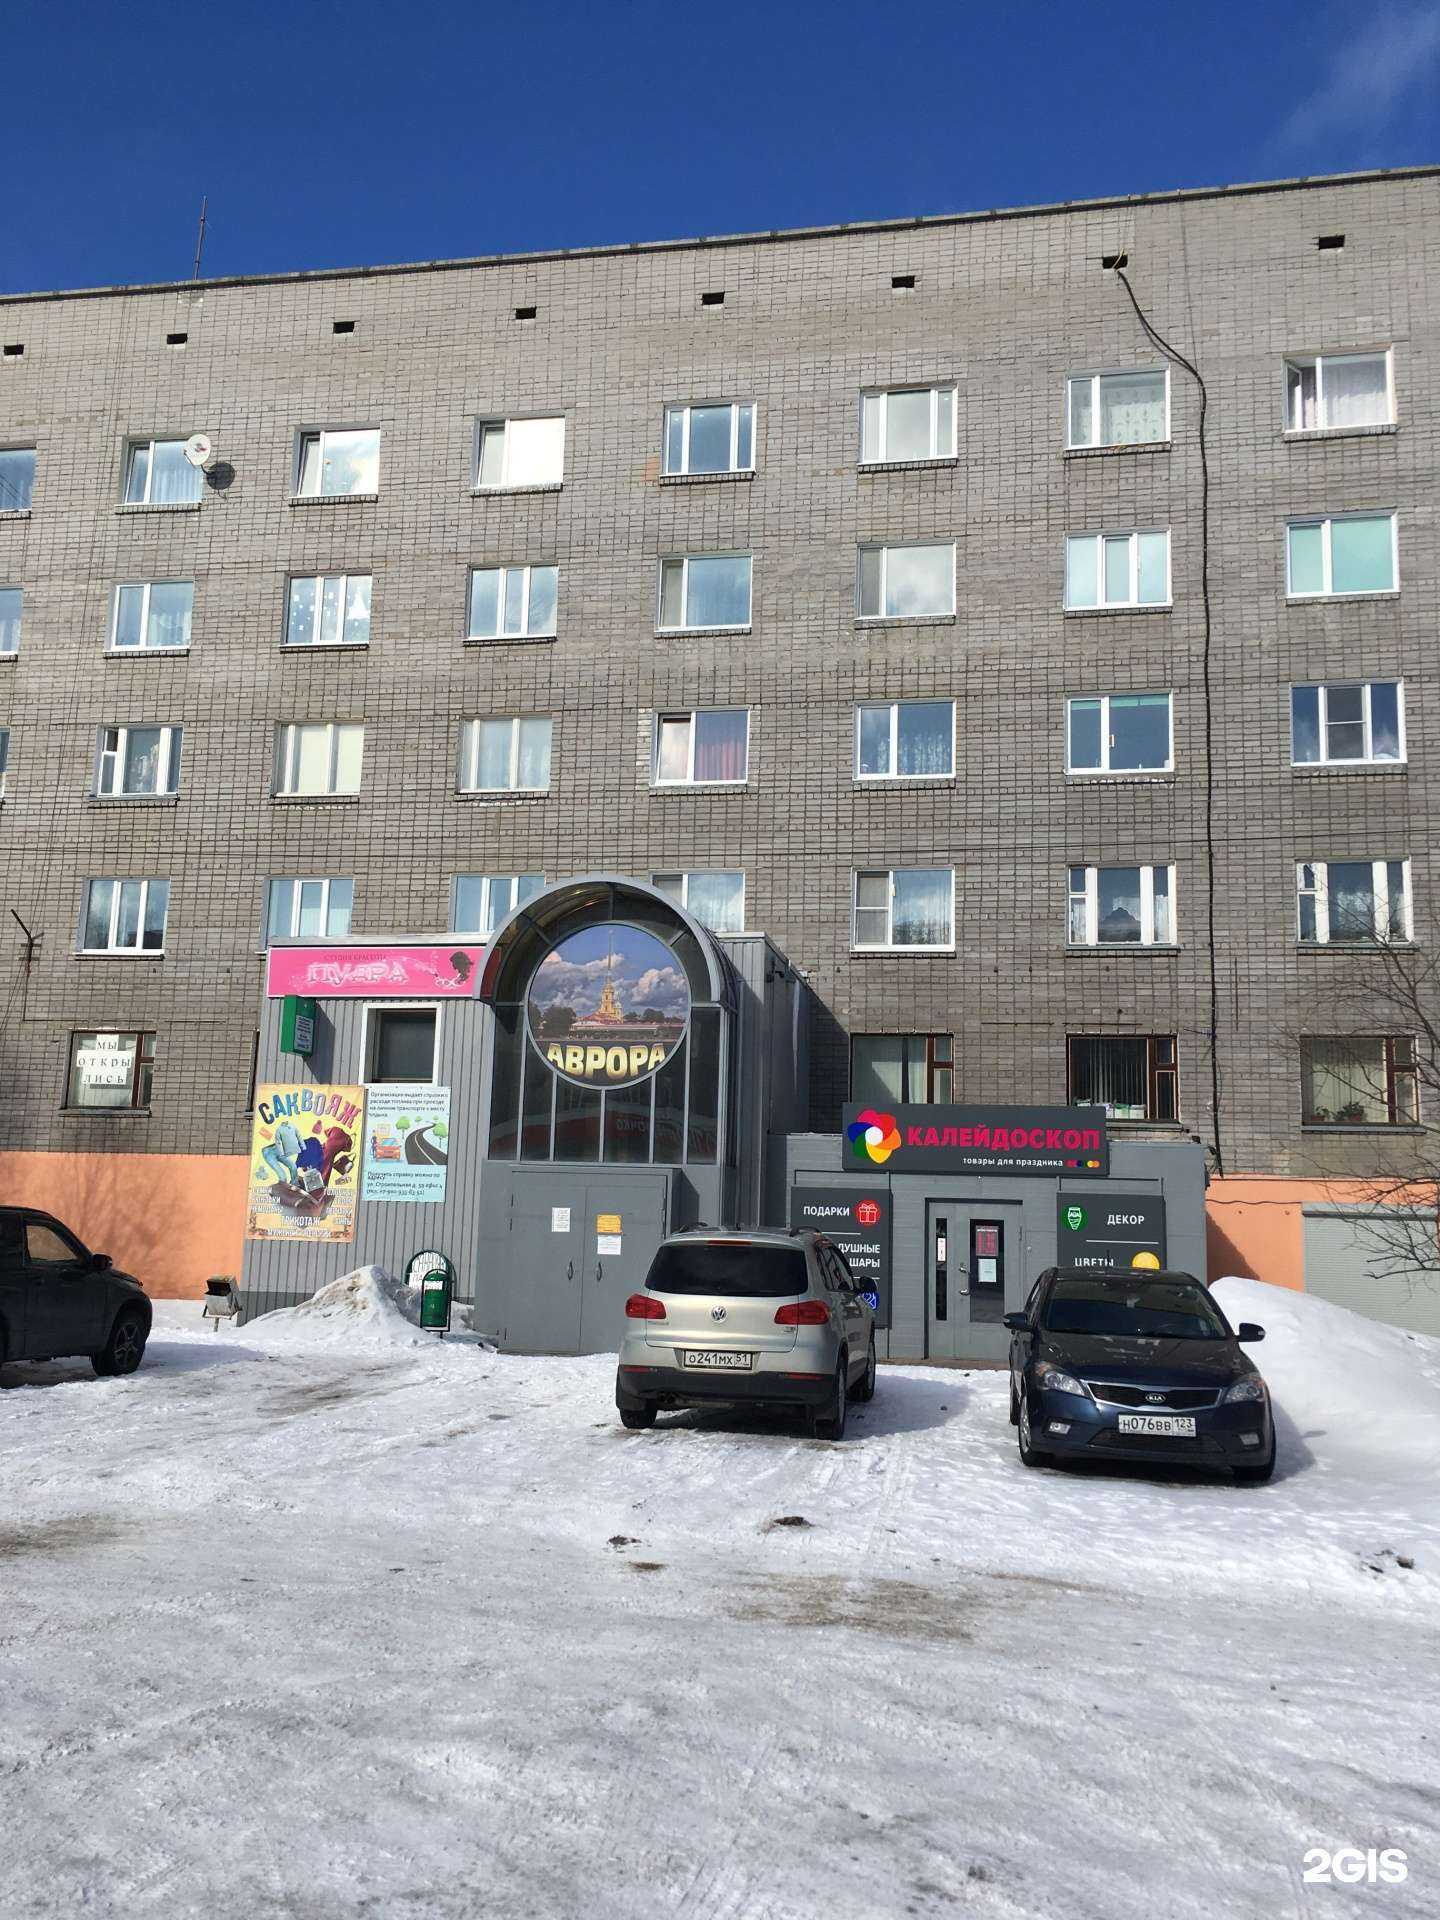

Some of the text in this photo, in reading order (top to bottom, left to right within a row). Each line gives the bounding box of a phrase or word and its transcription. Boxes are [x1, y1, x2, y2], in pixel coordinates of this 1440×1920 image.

[307, 962, 409, 987] ПУДРА
[97, 1041, 118, 1050] МЫ
[547, 1042, 666, 1079] АВРОРА
[258, 1087, 362, 1129] САКВОЯЖ
[907, 1123, 1100, 1150] КАЛЕЙДОСКОП
[963, 1157, 1063, 1167] товары для праздника
[803, 1205, 850, 1217] ПОДАРКИ
[281, 1215, 321, 1227] ТРИКОТАЖ
[1107, 1214, 1145, 1226] ДЕКОР
[838, 1242, 880, 1254] ДУШНЫЕ
[849, 1257, 880, 1268] ШАРЫ
